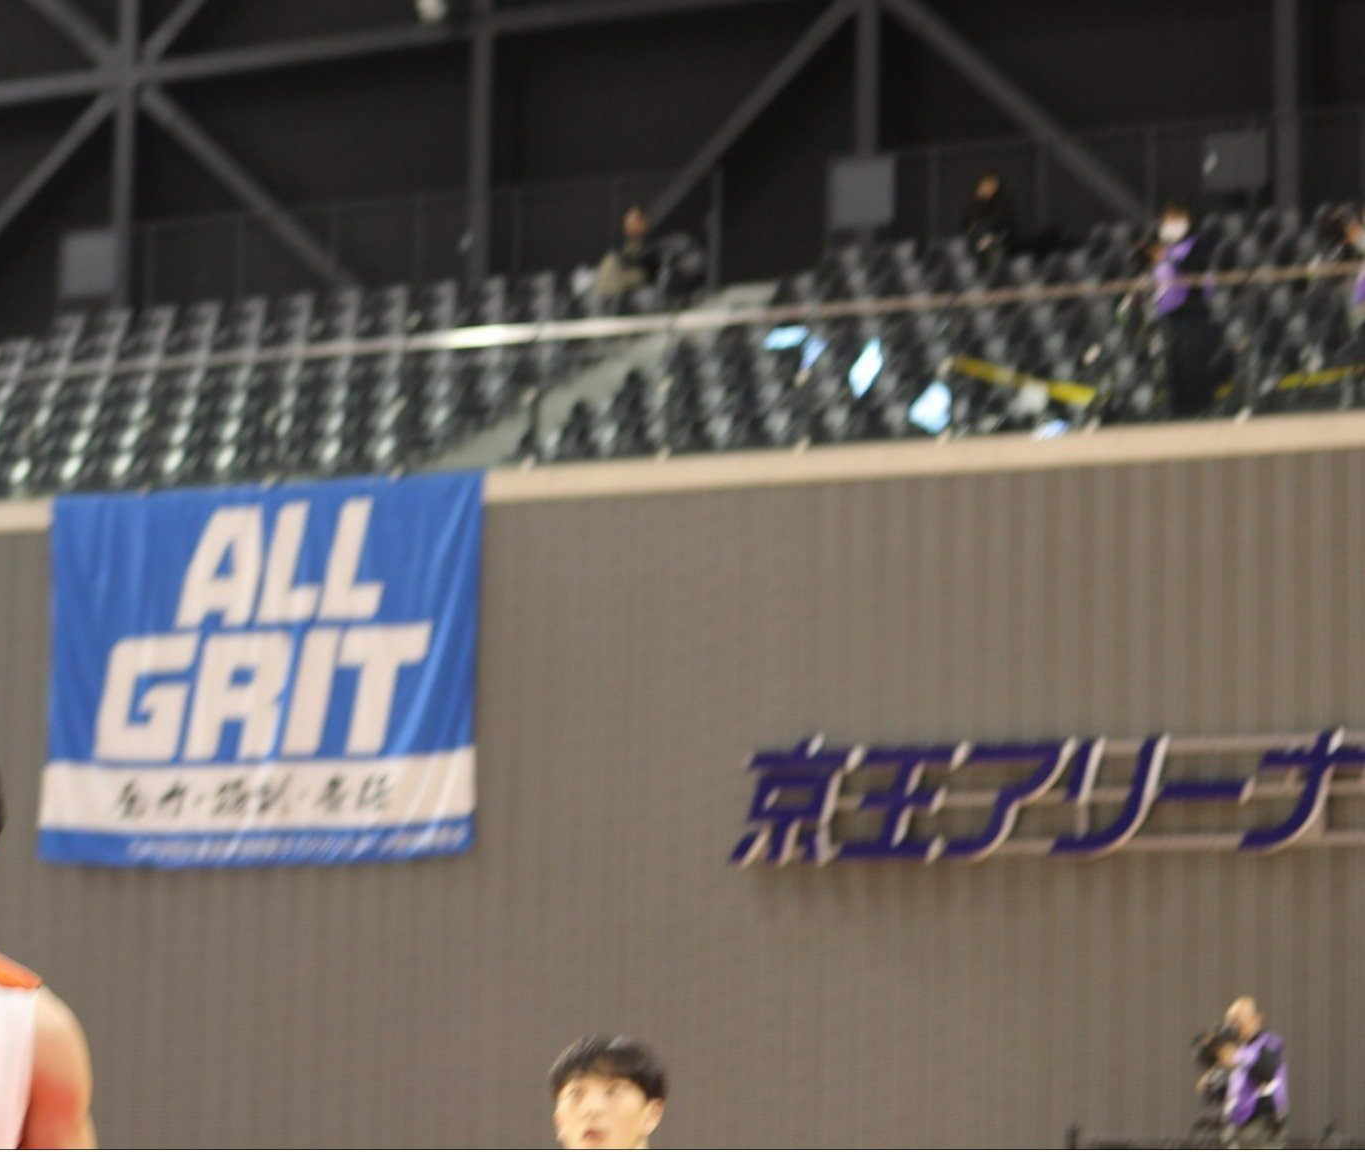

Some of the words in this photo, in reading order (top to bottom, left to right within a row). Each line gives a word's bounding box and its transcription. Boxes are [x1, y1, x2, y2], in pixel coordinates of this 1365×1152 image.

[176, 497, 385, 629] ALL
[94, 619, 434, 763] GRIT
[727, 727, 1365, 868] 京王アリーナ
